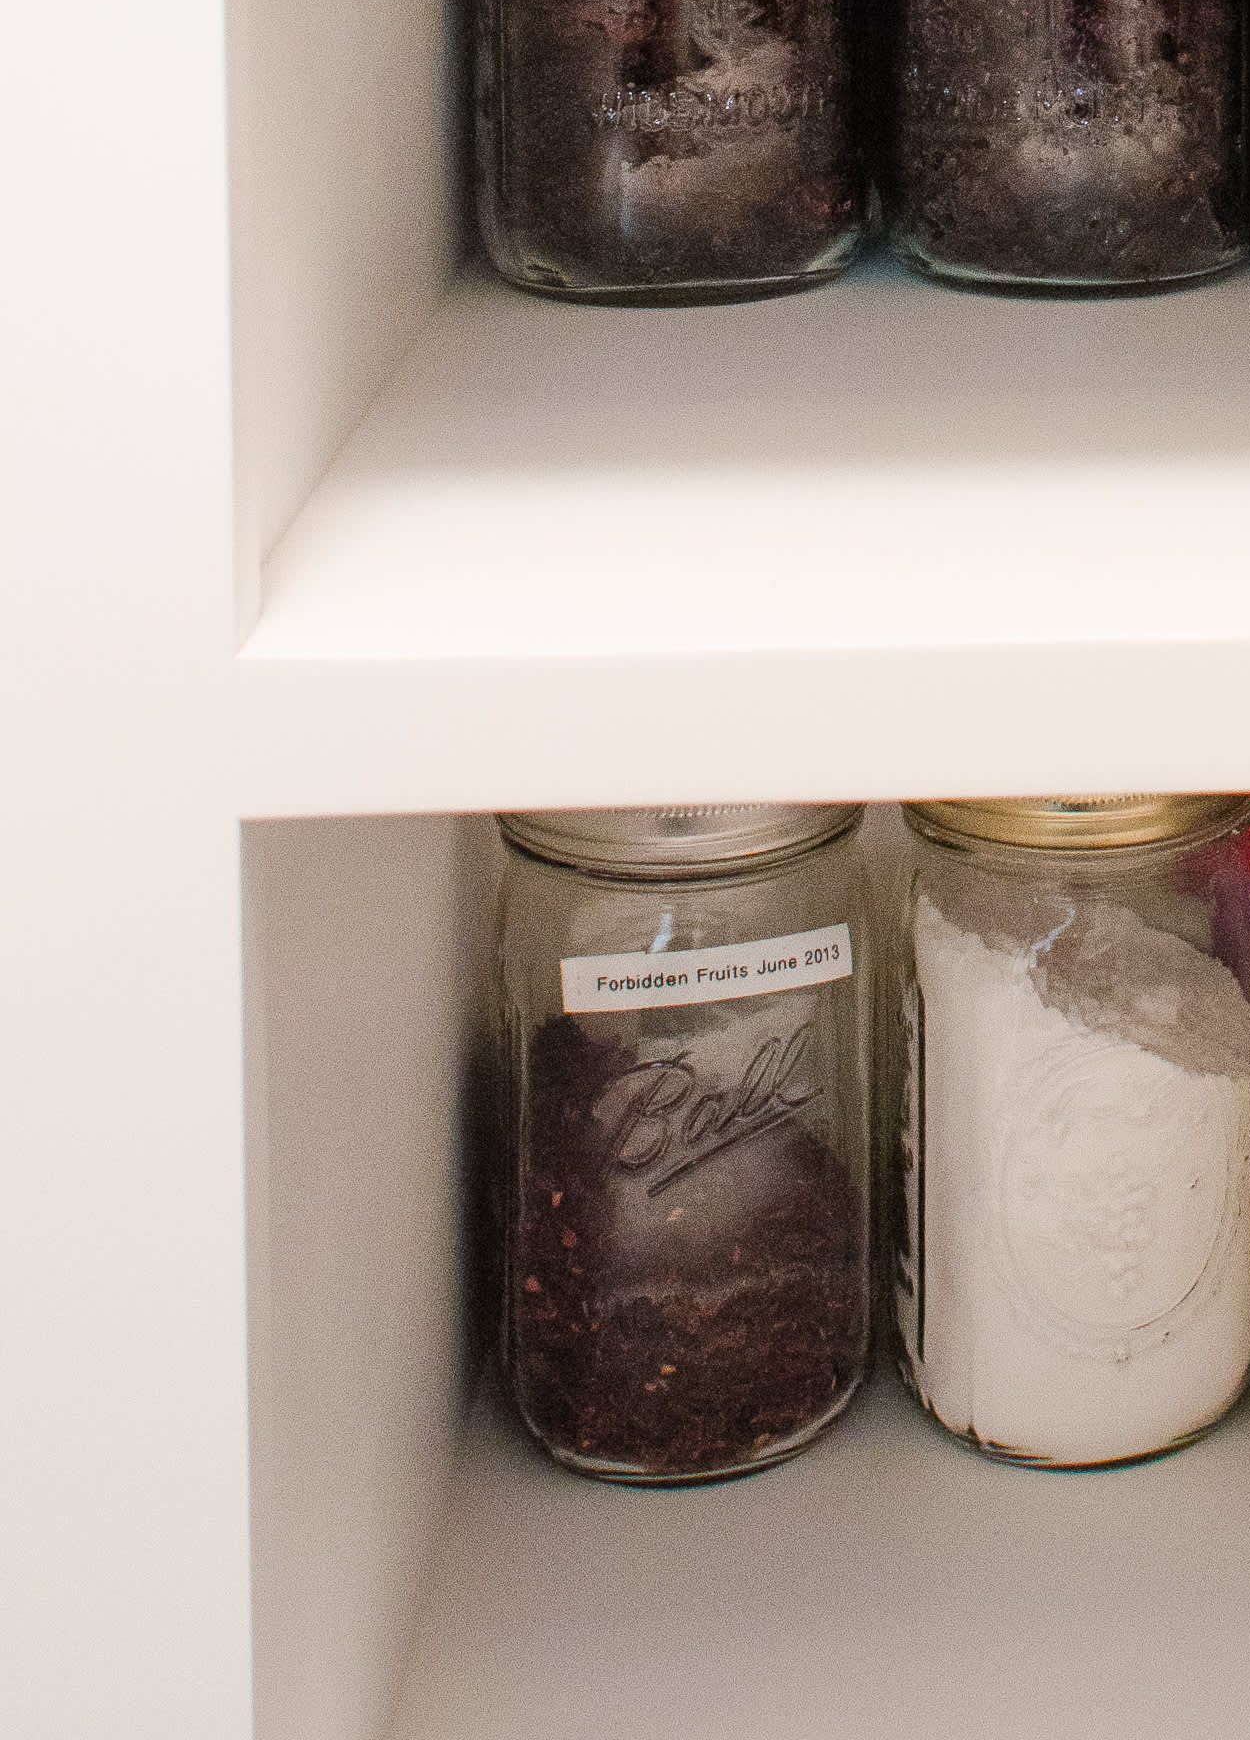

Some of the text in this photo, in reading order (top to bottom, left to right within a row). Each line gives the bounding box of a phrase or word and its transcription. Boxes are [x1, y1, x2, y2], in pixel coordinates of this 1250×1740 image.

[596, 943, 840, 992] Forbidden Fruits June 2013
[594, 1026, 824, 1178] Ball
